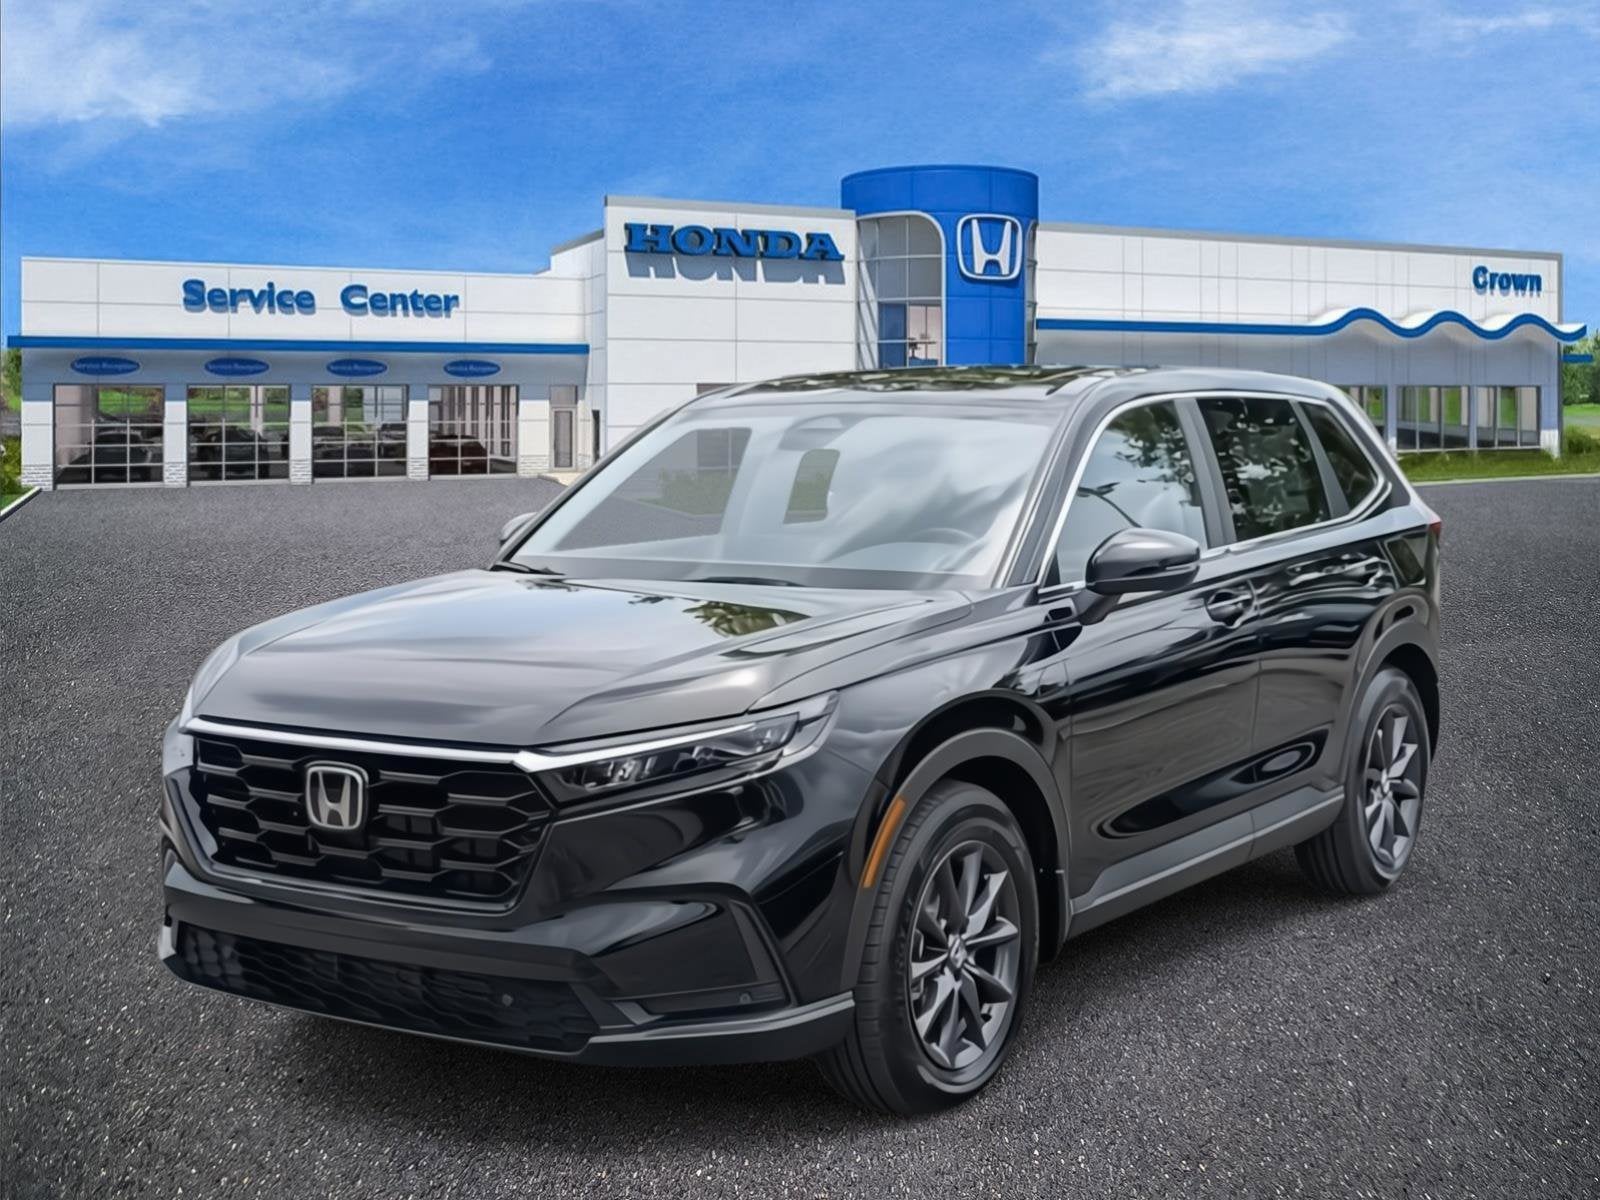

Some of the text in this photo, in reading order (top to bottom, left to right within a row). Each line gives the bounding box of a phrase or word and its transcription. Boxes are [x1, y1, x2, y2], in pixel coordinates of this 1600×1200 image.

[624, 223, 845, 261] HONDA
[1472, 265, 1542, 292] Crown
[182, 279, 460, 313] Service Center
